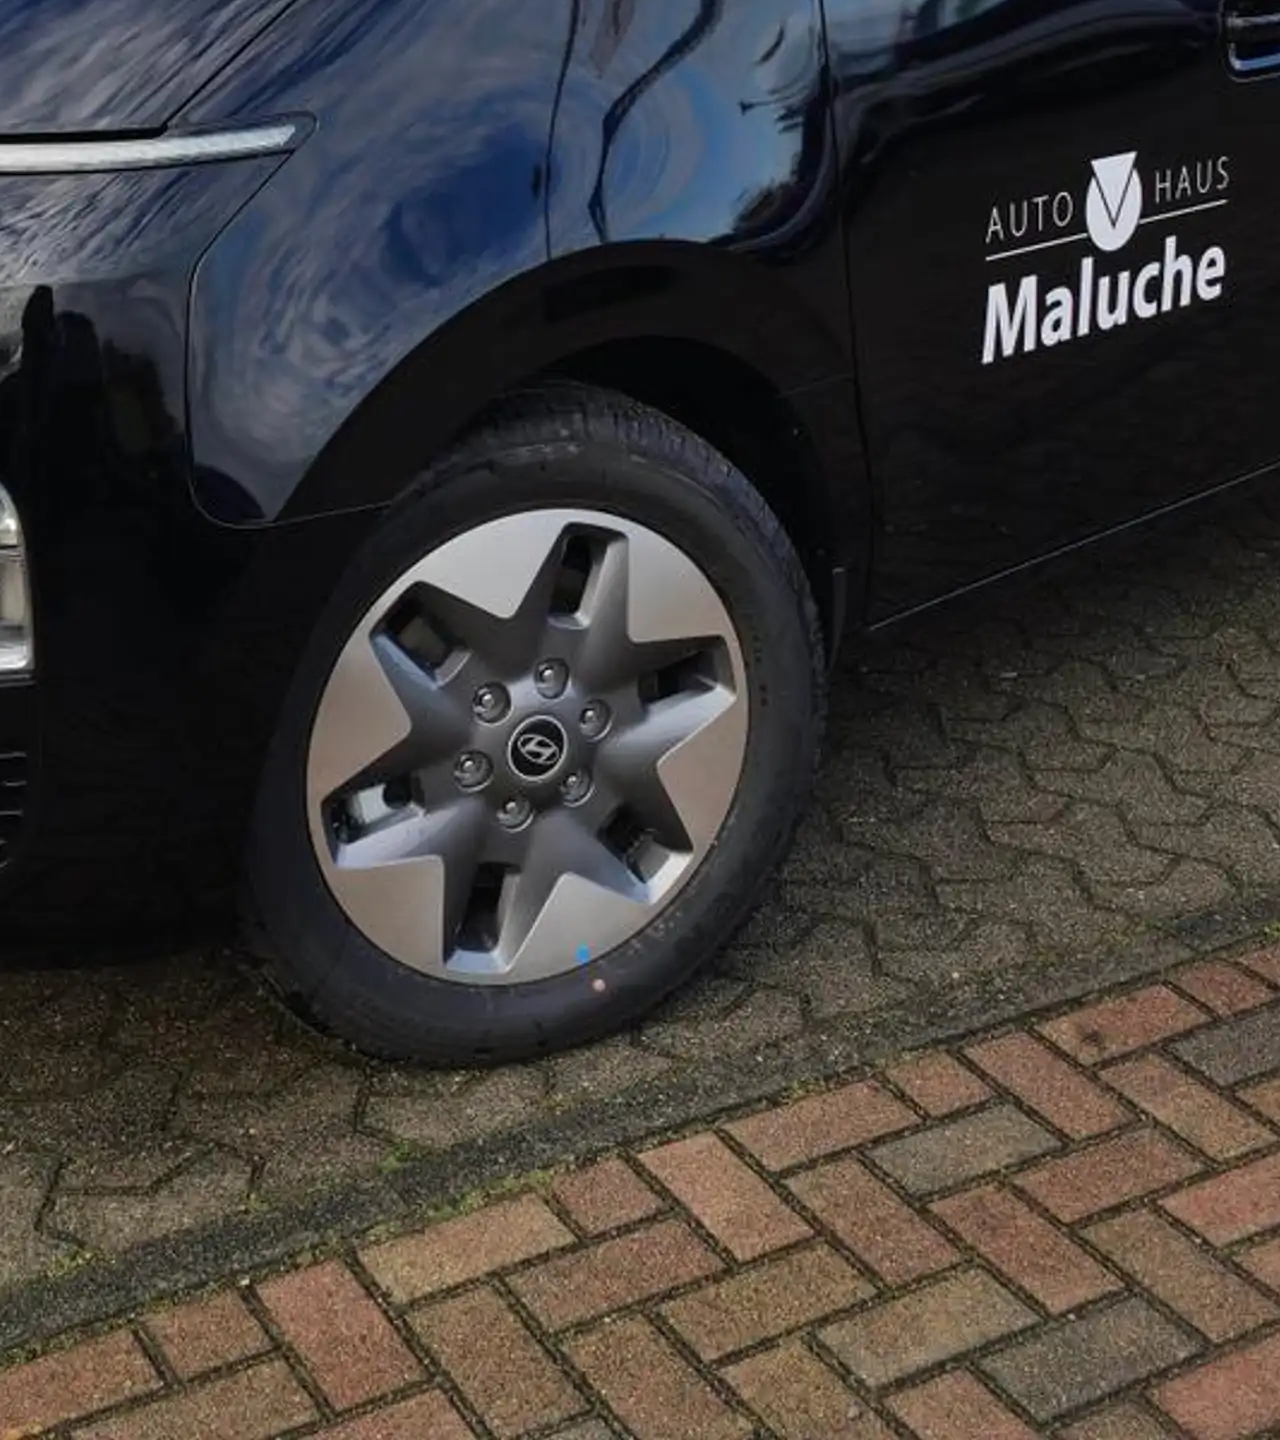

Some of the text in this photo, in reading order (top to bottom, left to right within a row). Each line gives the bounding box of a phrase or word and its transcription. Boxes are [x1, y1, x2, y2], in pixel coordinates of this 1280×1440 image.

[985, 156, 1230, 243] AUTO HAUS
[981, 235, 1226, 365] Maluche
